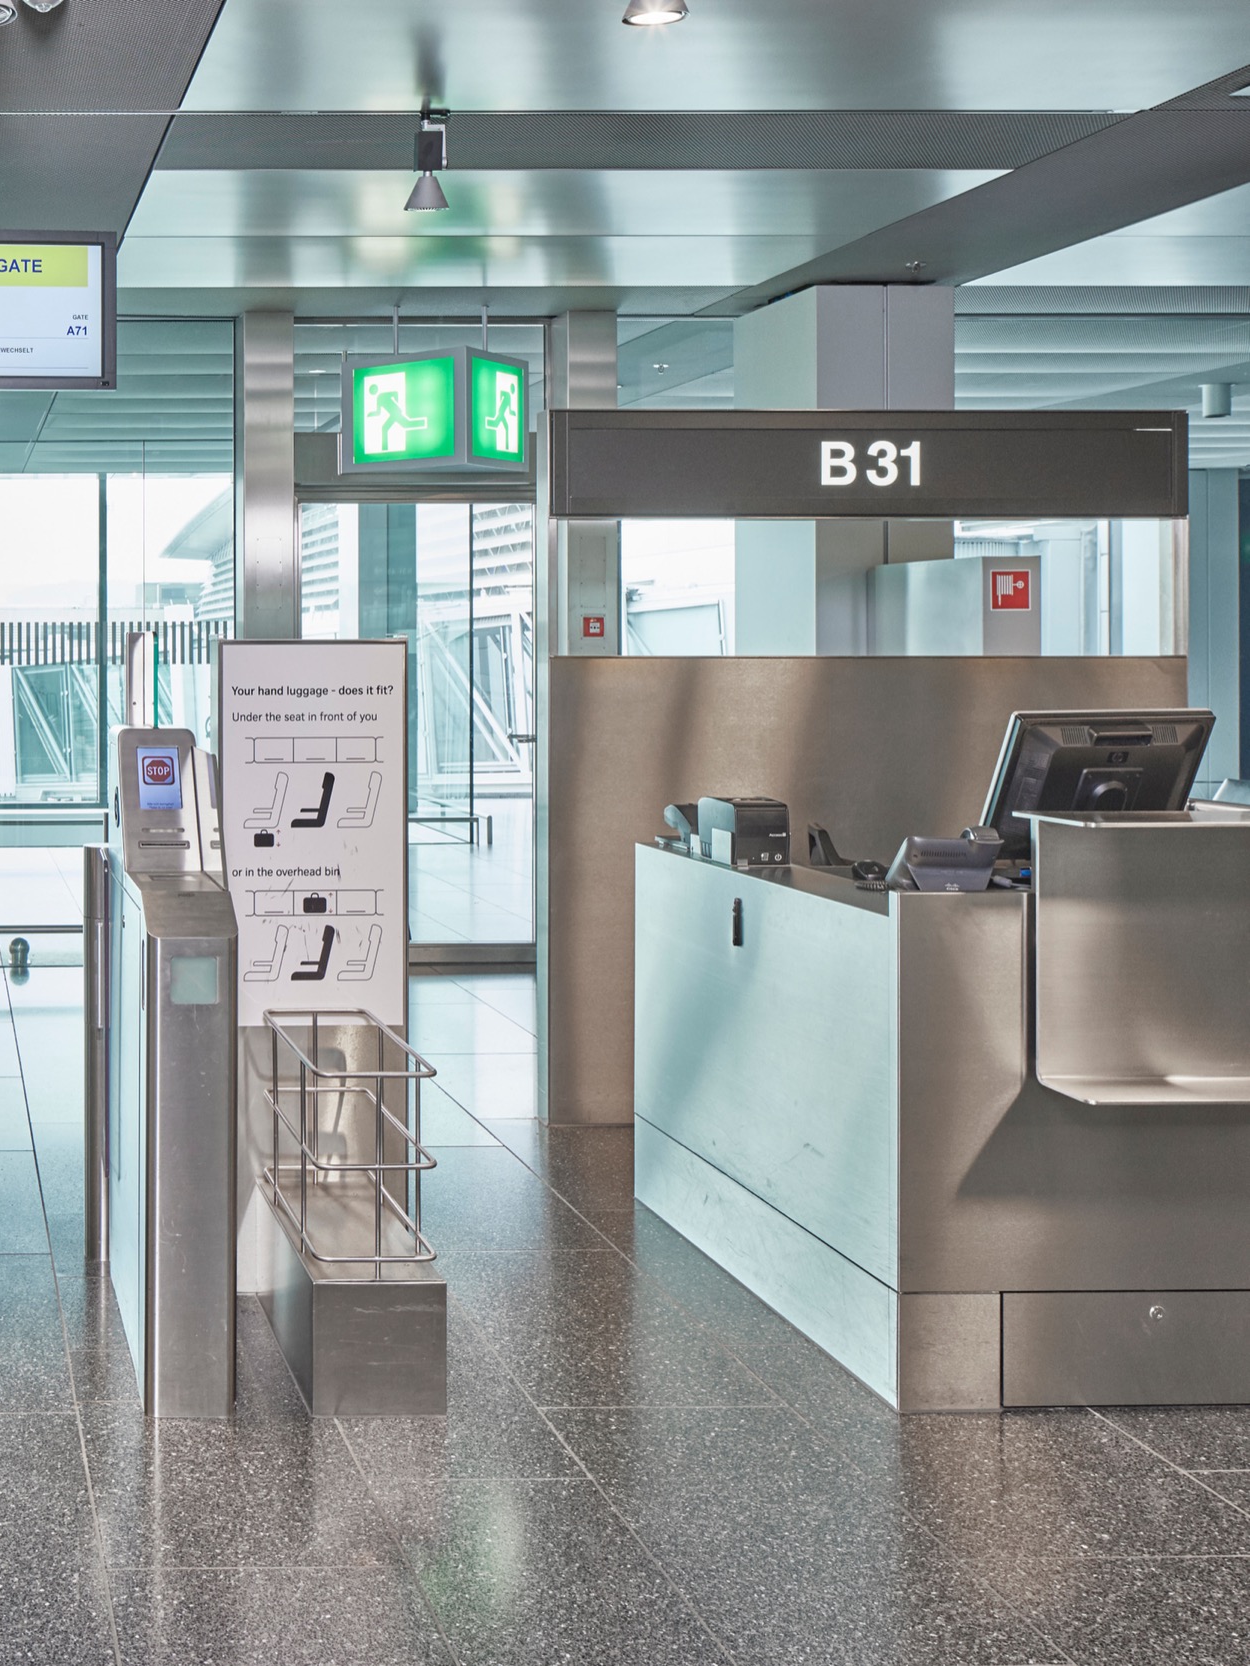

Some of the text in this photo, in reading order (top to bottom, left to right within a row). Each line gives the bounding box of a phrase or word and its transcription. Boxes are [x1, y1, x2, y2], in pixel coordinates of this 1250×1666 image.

[66, 325, 88, 336] A71
[231, 685, 255, 696] Your
[257, 685, 284, 696] hand
[286, 685, 329, 698] luggage
[338, 685, 364, 696] does
[366, 685, 374, 695] it
[376, 684, 394, 695] fit?
[232, 711, 378, 724] Under the seat in front of you
[147, 766, 170, 776] STOP
[231, 866, 341, 877] or in the overhead bin
